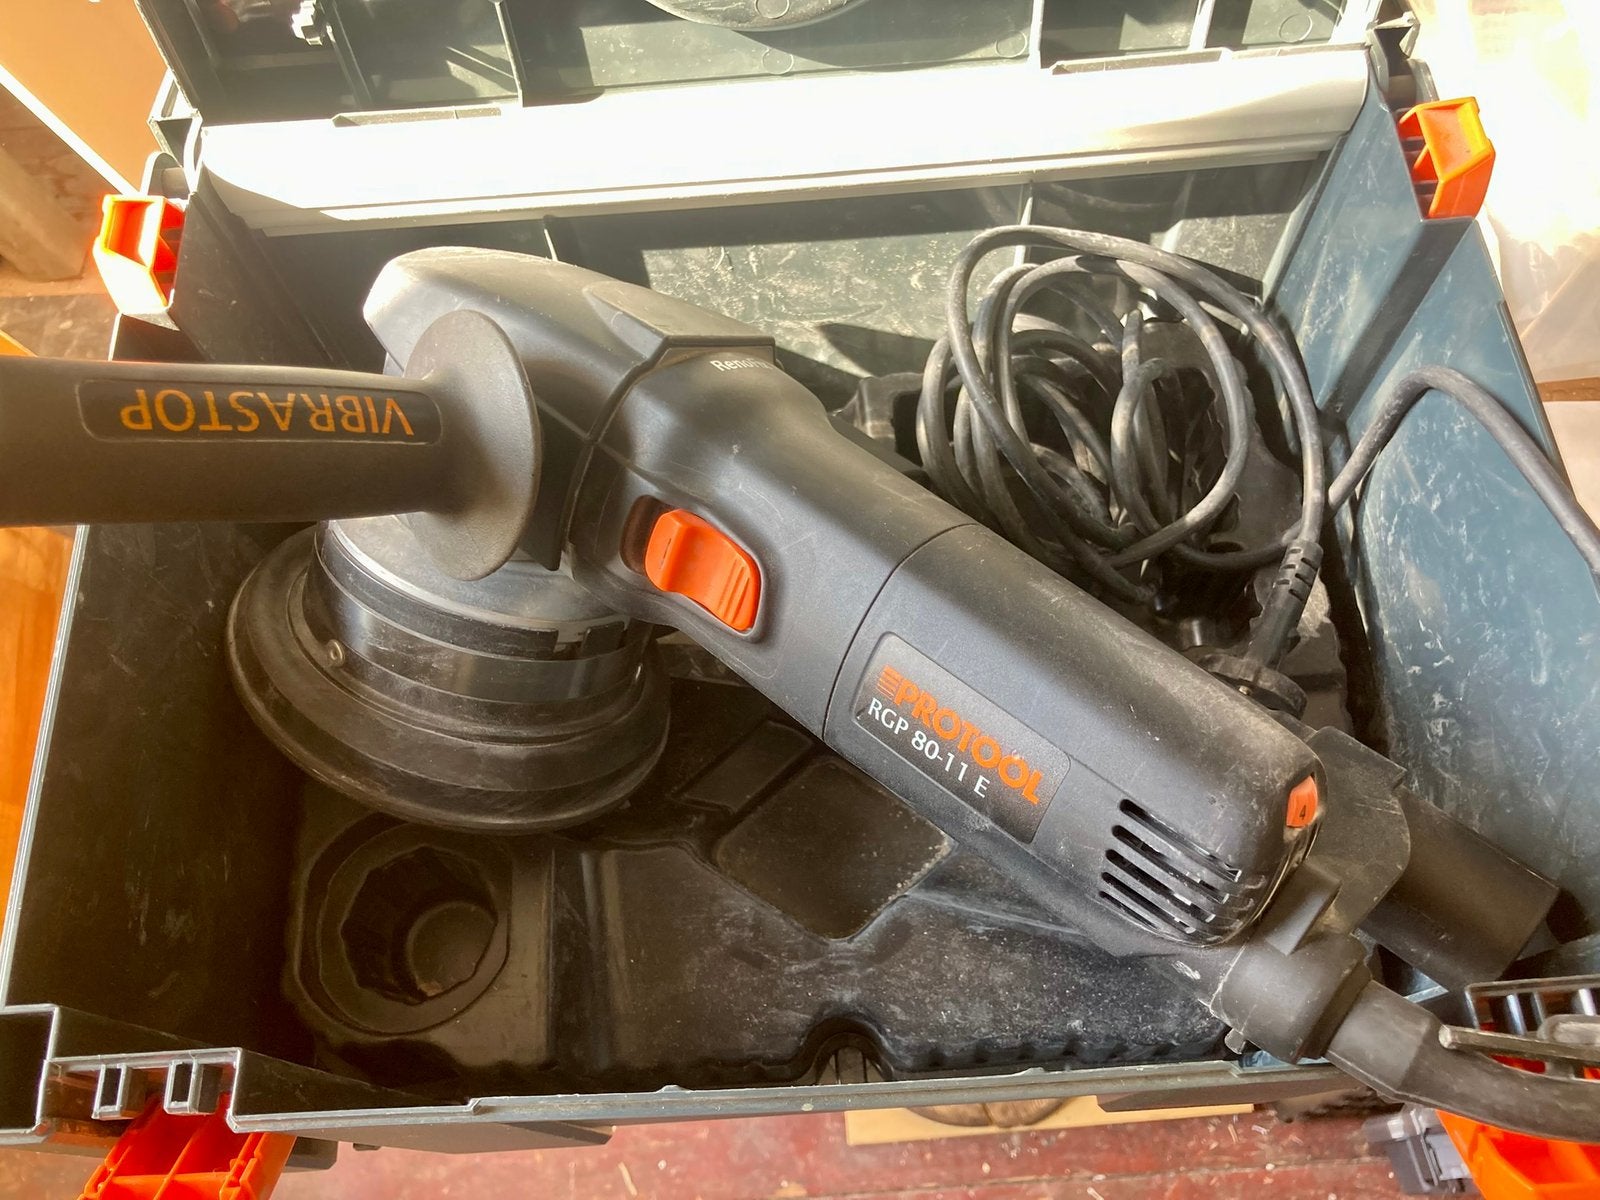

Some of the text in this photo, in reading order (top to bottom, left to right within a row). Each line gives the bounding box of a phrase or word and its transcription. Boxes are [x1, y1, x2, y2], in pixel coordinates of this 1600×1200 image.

[120, 388, 414, 436] VIBRASTOP
[867, 697, 991, 798] RGP 80-11 E
[892, 676, 1044, 805] PROTOOL
[1299, 804, 1307, 821] 4
